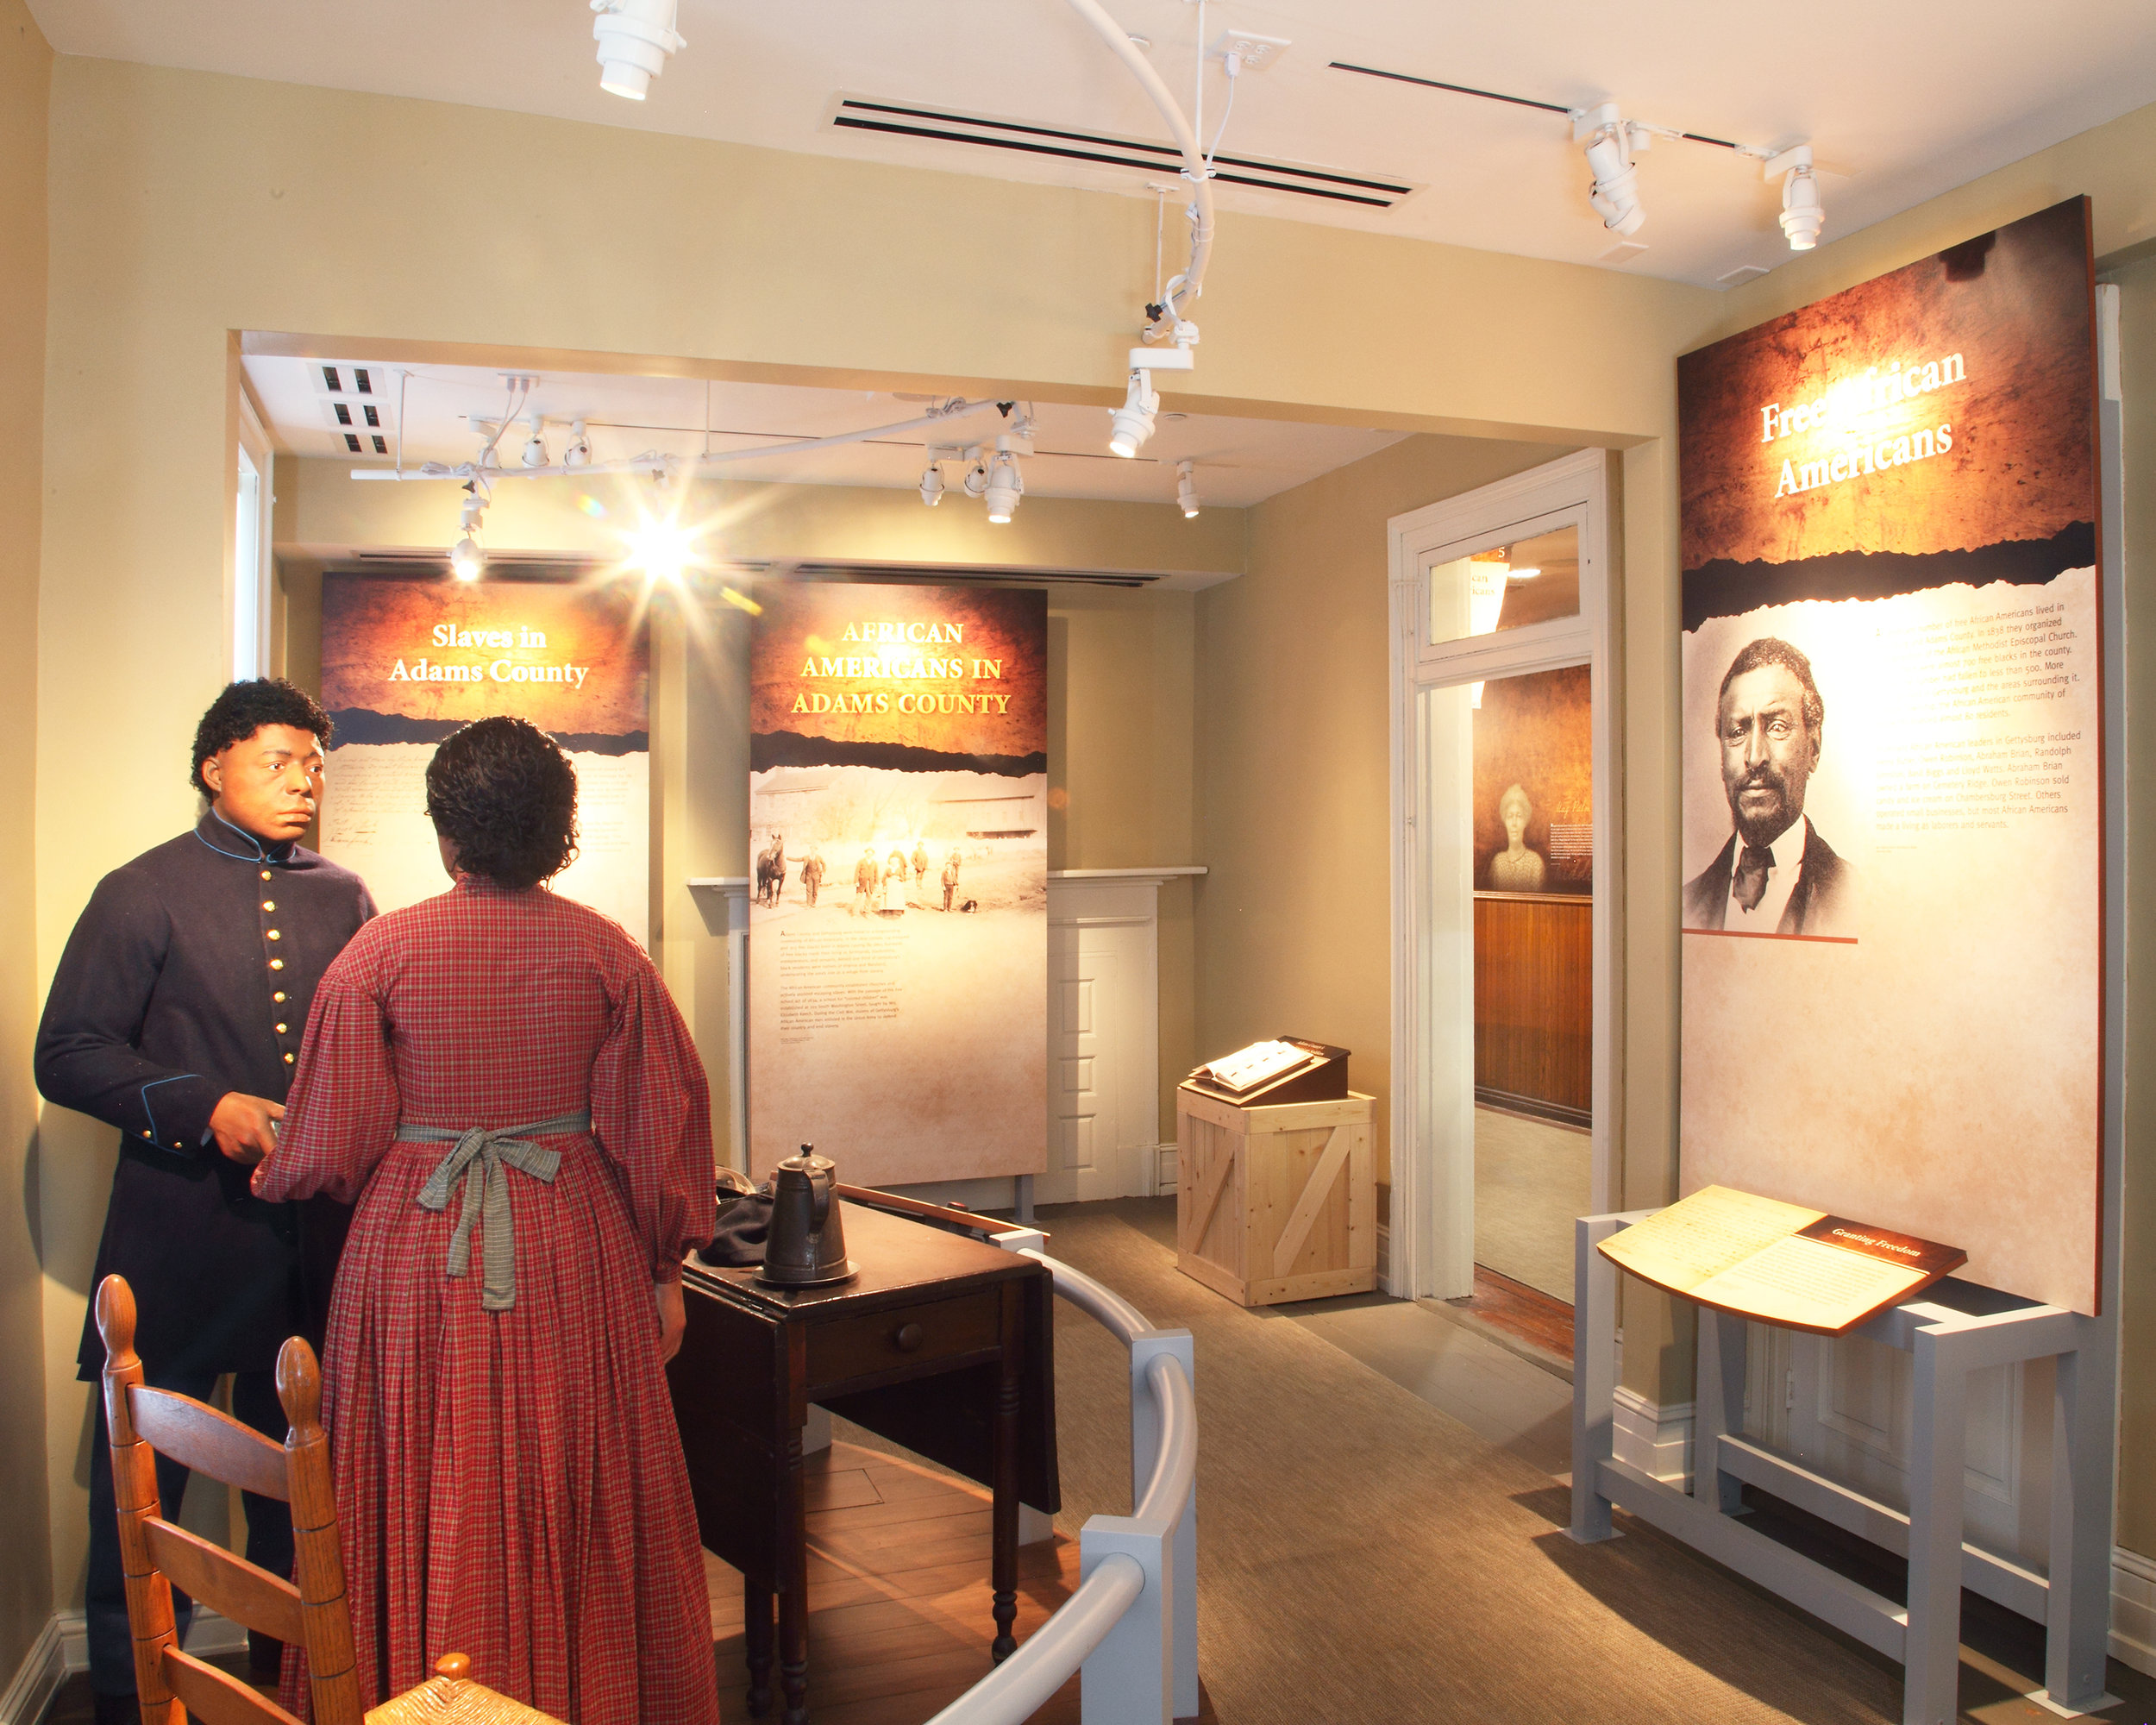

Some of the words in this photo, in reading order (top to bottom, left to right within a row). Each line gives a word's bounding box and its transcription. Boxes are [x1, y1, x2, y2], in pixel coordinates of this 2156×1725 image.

[1760, 397, 1829, 443] Free
[1774, 423, 1952, 499] Americans
[1498, 547, 1505, 558] 5
[1970, 615, 1994, 624] African
[1996, 608, 2034, 620] Americans
[2035, 604, 2054, 615] lived
[2057, 602, 2065, 612] in
[432, 624, 514, 648] Slaves
[519, 625, 547, 648] in
[842, 621, 964, 643] AFRICAN
[1987, 625, 2004, 637] 1838
[2007, 624, 2022, 634] they
[2025, 617, 2062, 631] organized
[1972, 639, 2009, 651] Methodist
[2010, 633, 2046, 647] Episcopal
[2048, 630, 2078, 642] Church.
[1978, 655, 1992, 664] free
[1994, 652, 2017, 663] blacks
[2020, 650, 2028, 659] in
[2029, 649, 2041, 659] the
[2045, 646, 2072, 656] county.
[388, 658, 484, 681] Adams
[489, 659, 590, 689] County
[800, 656, 963, 679] AMERICANS
[972, 658, 1002, 679] IN
[1980, 669, 1988, 678] to
[1989, 668, 2004, 677] less
[2006, 667, 2022, 675] than
[2025, 664, 2042, 675] 500.
[2045, 662, 2064, 671] More
[1971, 683, 1985, 693] and
[1986, 681, 1998, 691] the
[2001, 681, 2021, 689] areas
[2023, 674, 2069, 687] surrounding
[2071, 673, 2080, 682] it.
[791, 693, 889, 714] ADAMS
[898, 693, 1012, 714] COUNTY
[1977, 695, 2010, 705] American
[2013, 690, 2054, 702] community
[2058, 687, 2066, 698] of
[1976, 709, 2010, 719] residents.
[1996, 737, 2002, 745] in
[2005, 734, 2045, 745] Gettysburg
[2047, 731, 2081, 742] included
[1976, 751, 2009, 760] Abraham
[2010, 749, 2033, 759] Brian,
[2035, 746, 2071, 757] Randolph
[1983, 764, 2003, 774] Watts.
[2007, 763, 2040, 773] Abraham
[2043, 762, 2063, 771] Brian
[1966, 779, 1989, 789] Ridge.
[1991, 778, 2012, 787] Owen
[2015, 776, 2050, 787] Robinson
[2053, 775, 2070, 785] sold
[1956, 793, 2007, 803] Chambersburg
[2009, 791, 2034, 801] Street.
[2035, 790, 2061, 800] Others
[1967, 806, 1979, 815] but
[1982, 806, 2000, 815] most
[2001, 805, 2027, 815] African
[2029, 805, 2069, 814] Americans
[1960, 820, 1974, 830] and
[1977, 820, 2009, 829] servants.
[1832, 1227, 1877, 1245] Granting
[1875, 1239, 1921, 1257] Freedom
